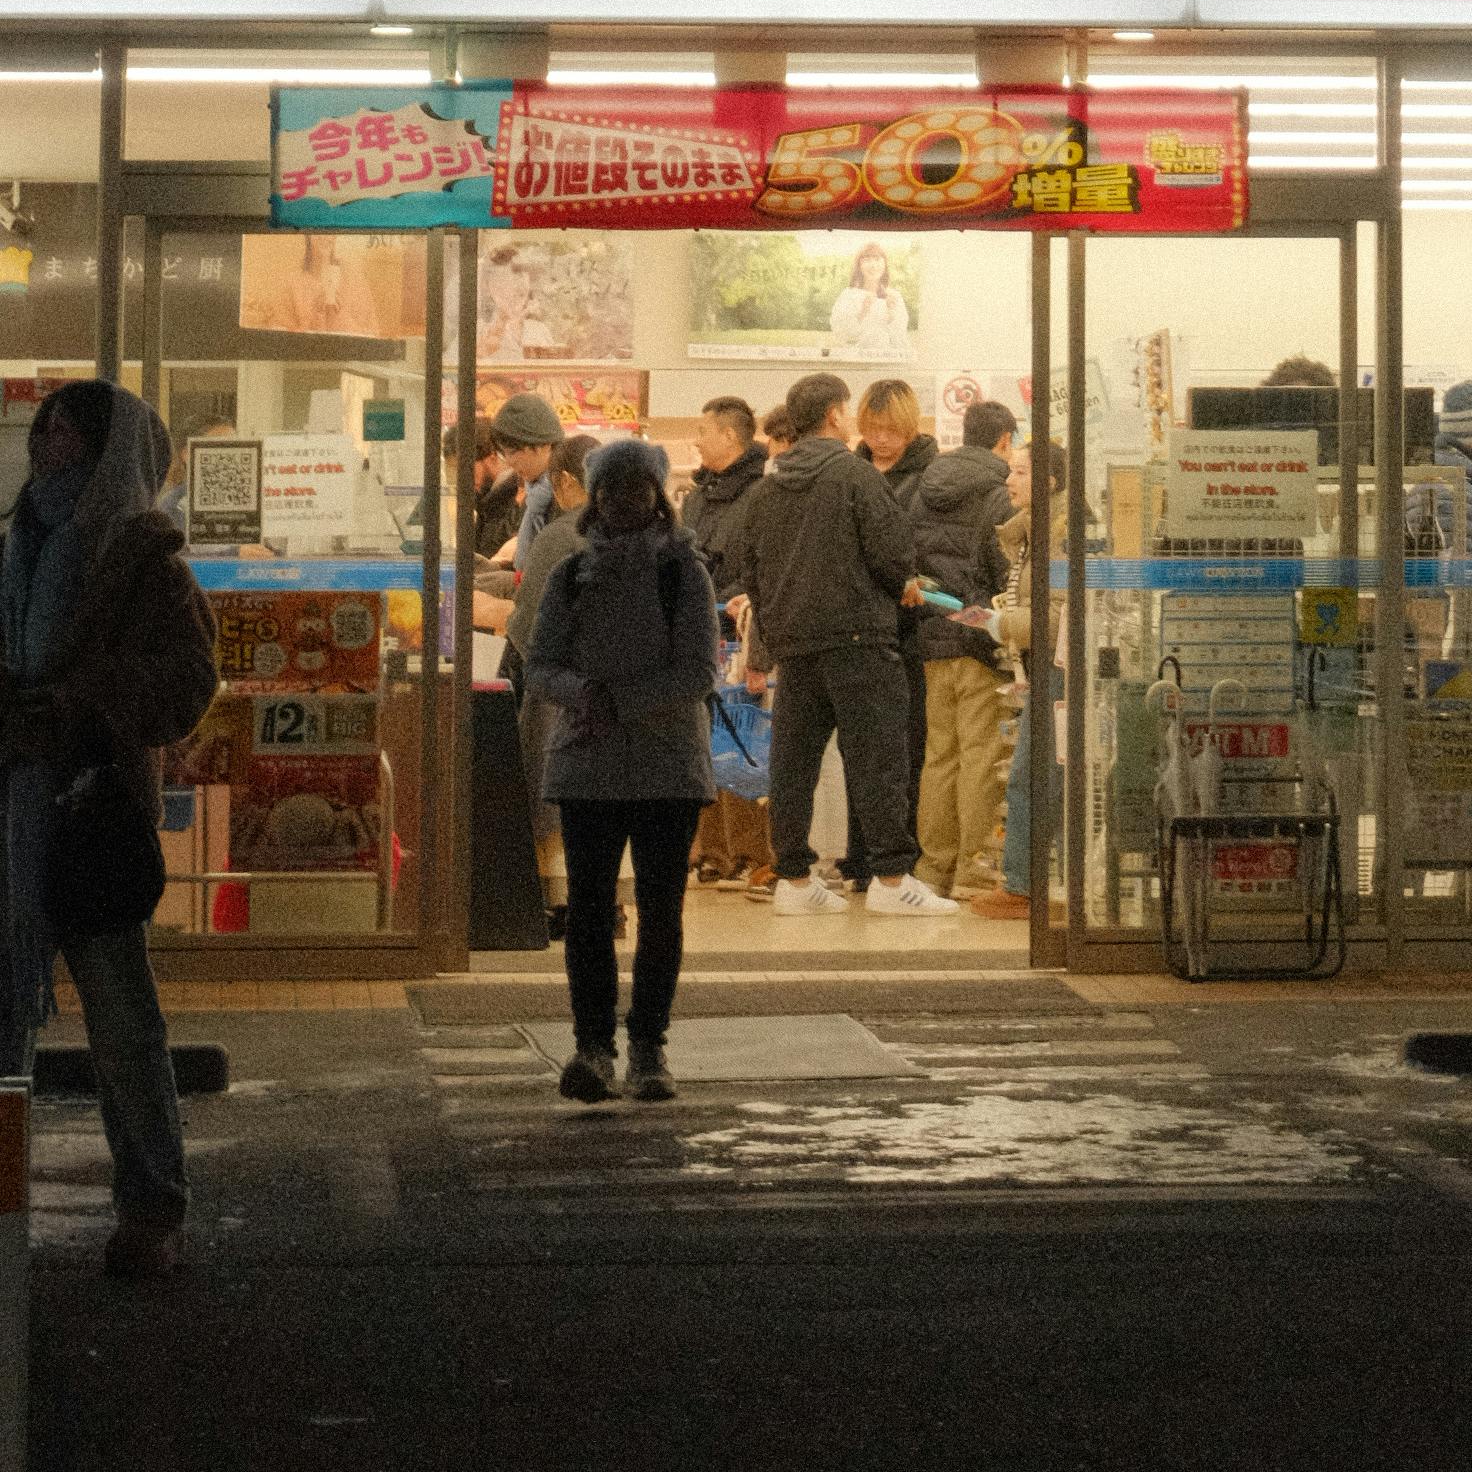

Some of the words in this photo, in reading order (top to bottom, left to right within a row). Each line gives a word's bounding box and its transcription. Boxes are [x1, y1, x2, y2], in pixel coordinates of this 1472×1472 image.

[309, 114, 428, 161] 今年も
[281, 141, 490, 201] チャレンジ!
[514, 123, 744, 197] お値段そのまま
[1012, 163, 1133, 213] 増量
[279, 463, 298, 474] eat
[300, 464, 312, 474] or
[1178, 460, 1201, 472] You
[1204, 460, 1236, 472] can't
[1238, 461, 1258, 472] eat
[1260, 462, 1273, 472] or
[284, 487, 317, 497] store.
[1220, 484, 1241, 496] the
[1243, 485, 1279, 496] store.
[261, 701, 305, 744] 12
